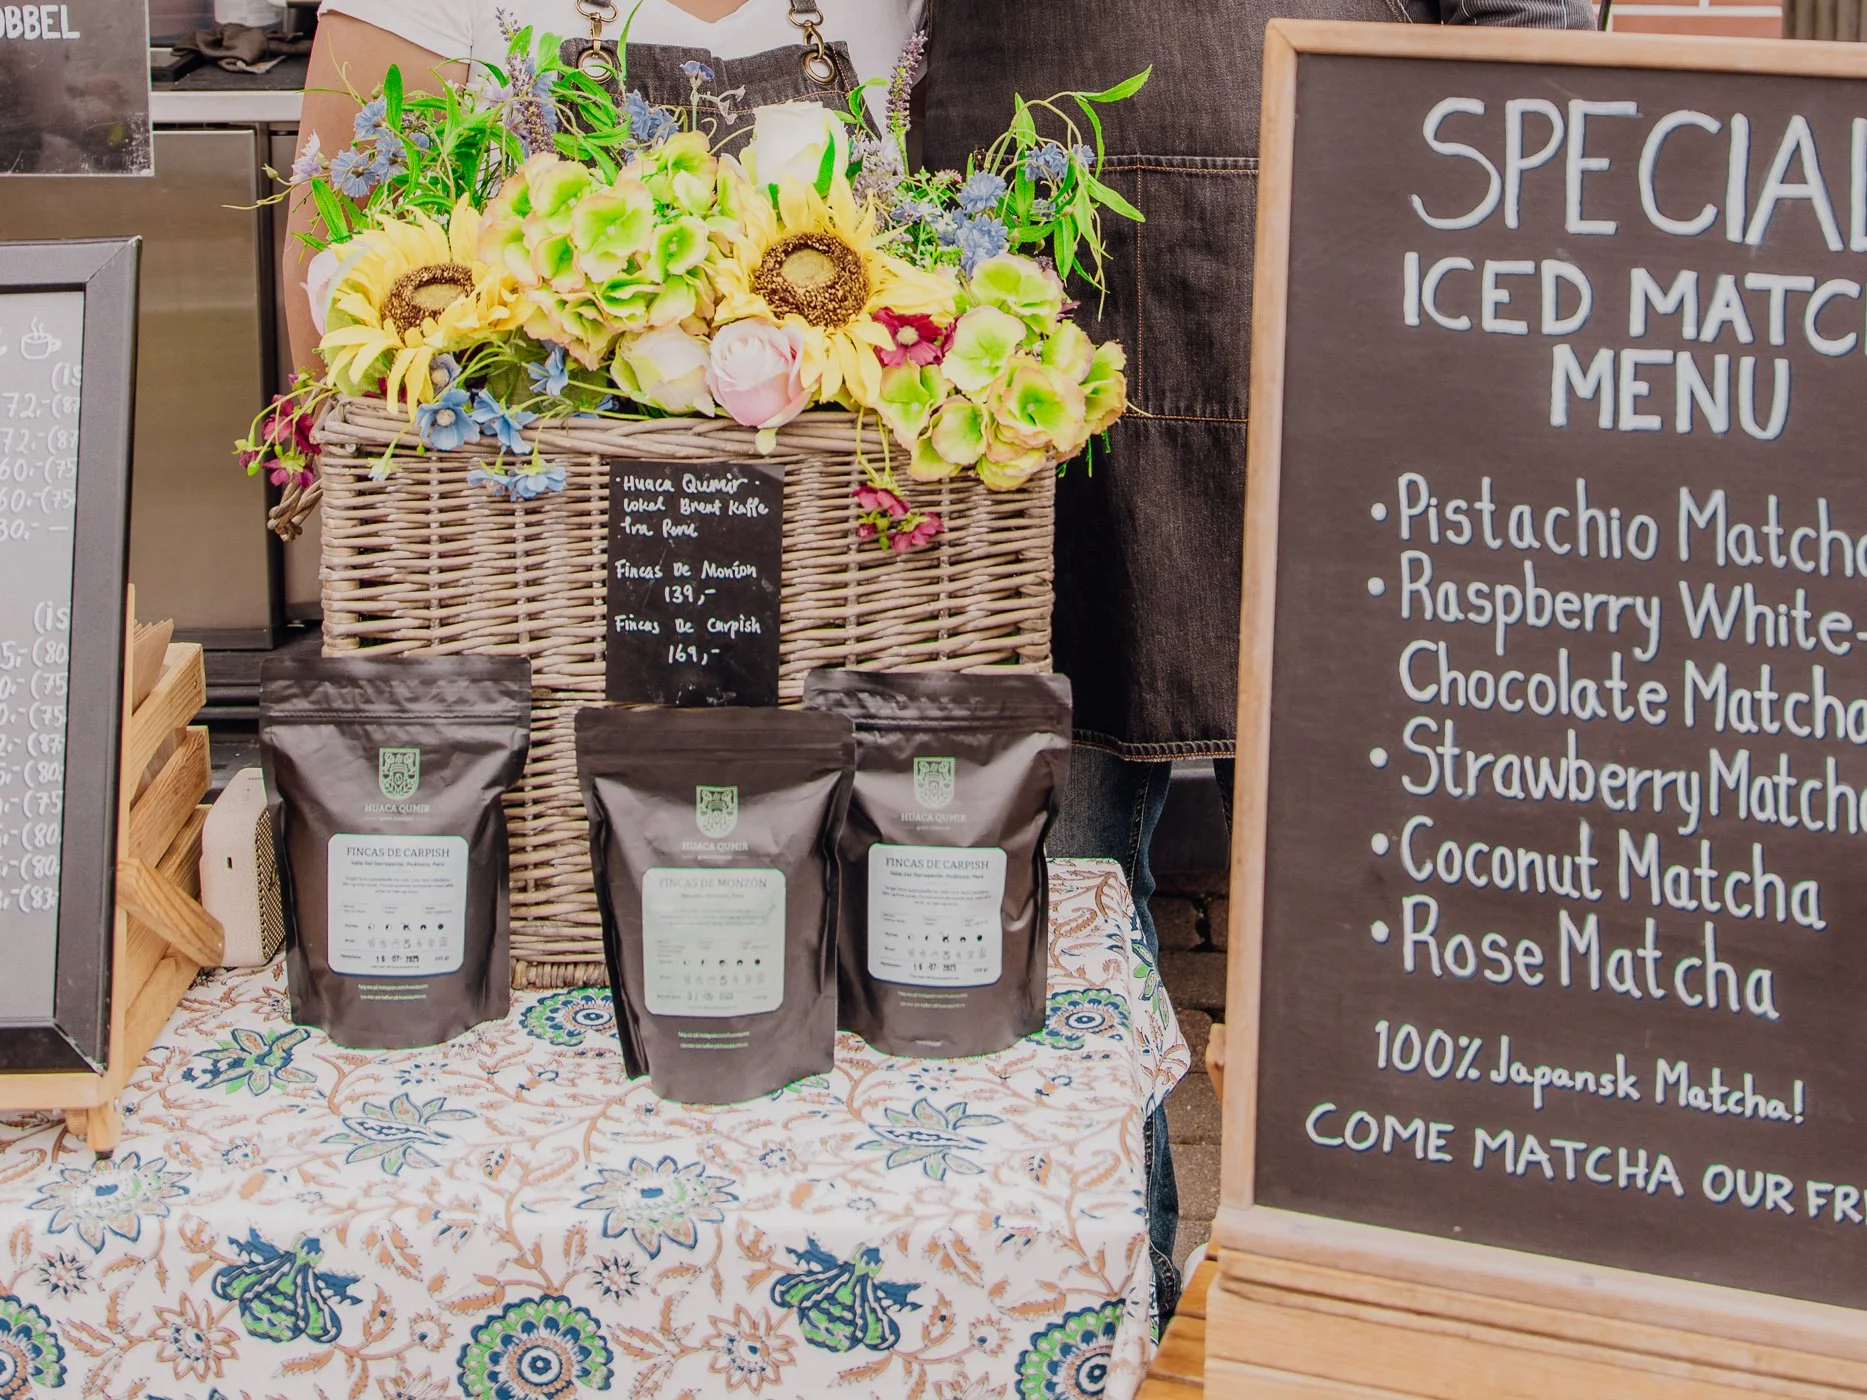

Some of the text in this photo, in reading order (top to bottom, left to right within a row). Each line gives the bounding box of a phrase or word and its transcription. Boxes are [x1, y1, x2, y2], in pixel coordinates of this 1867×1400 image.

[1403, 251, 1867, 355] ICED MATC
[1550, 343, 1789, 439] MENU
[1398, 472, 1657, 560] Pistachio
[614, 559, 663, 579] Fincas
[1400, 550, 1660, 661] Raspberry
[614, 614, 660, 634] Fincas
[1399, 639, 1668, 724] Chocolate
[364, 803, 430, 814] HUACA QUMIR
[1401, 716, 1700, 835] Strawberry
[346, 847, 450, 859] FINCAS DE CARPISH
[659, 876, 767, 889] FINCAS DE MONZÓN
[682, 841, 715, 851] HUACA
[885, 857, 989, 871] FINCAS DE CARPISH
[1401, 815, 1826, 929] Coconut Matcha
[1402, 894, 1780, 1020] Rose Matcha
[1375, 1020, 1804, 1124] 100% Japansk Matcha!
[1305, 1102, 1867, 1223] COME MATCHA OUR FR
